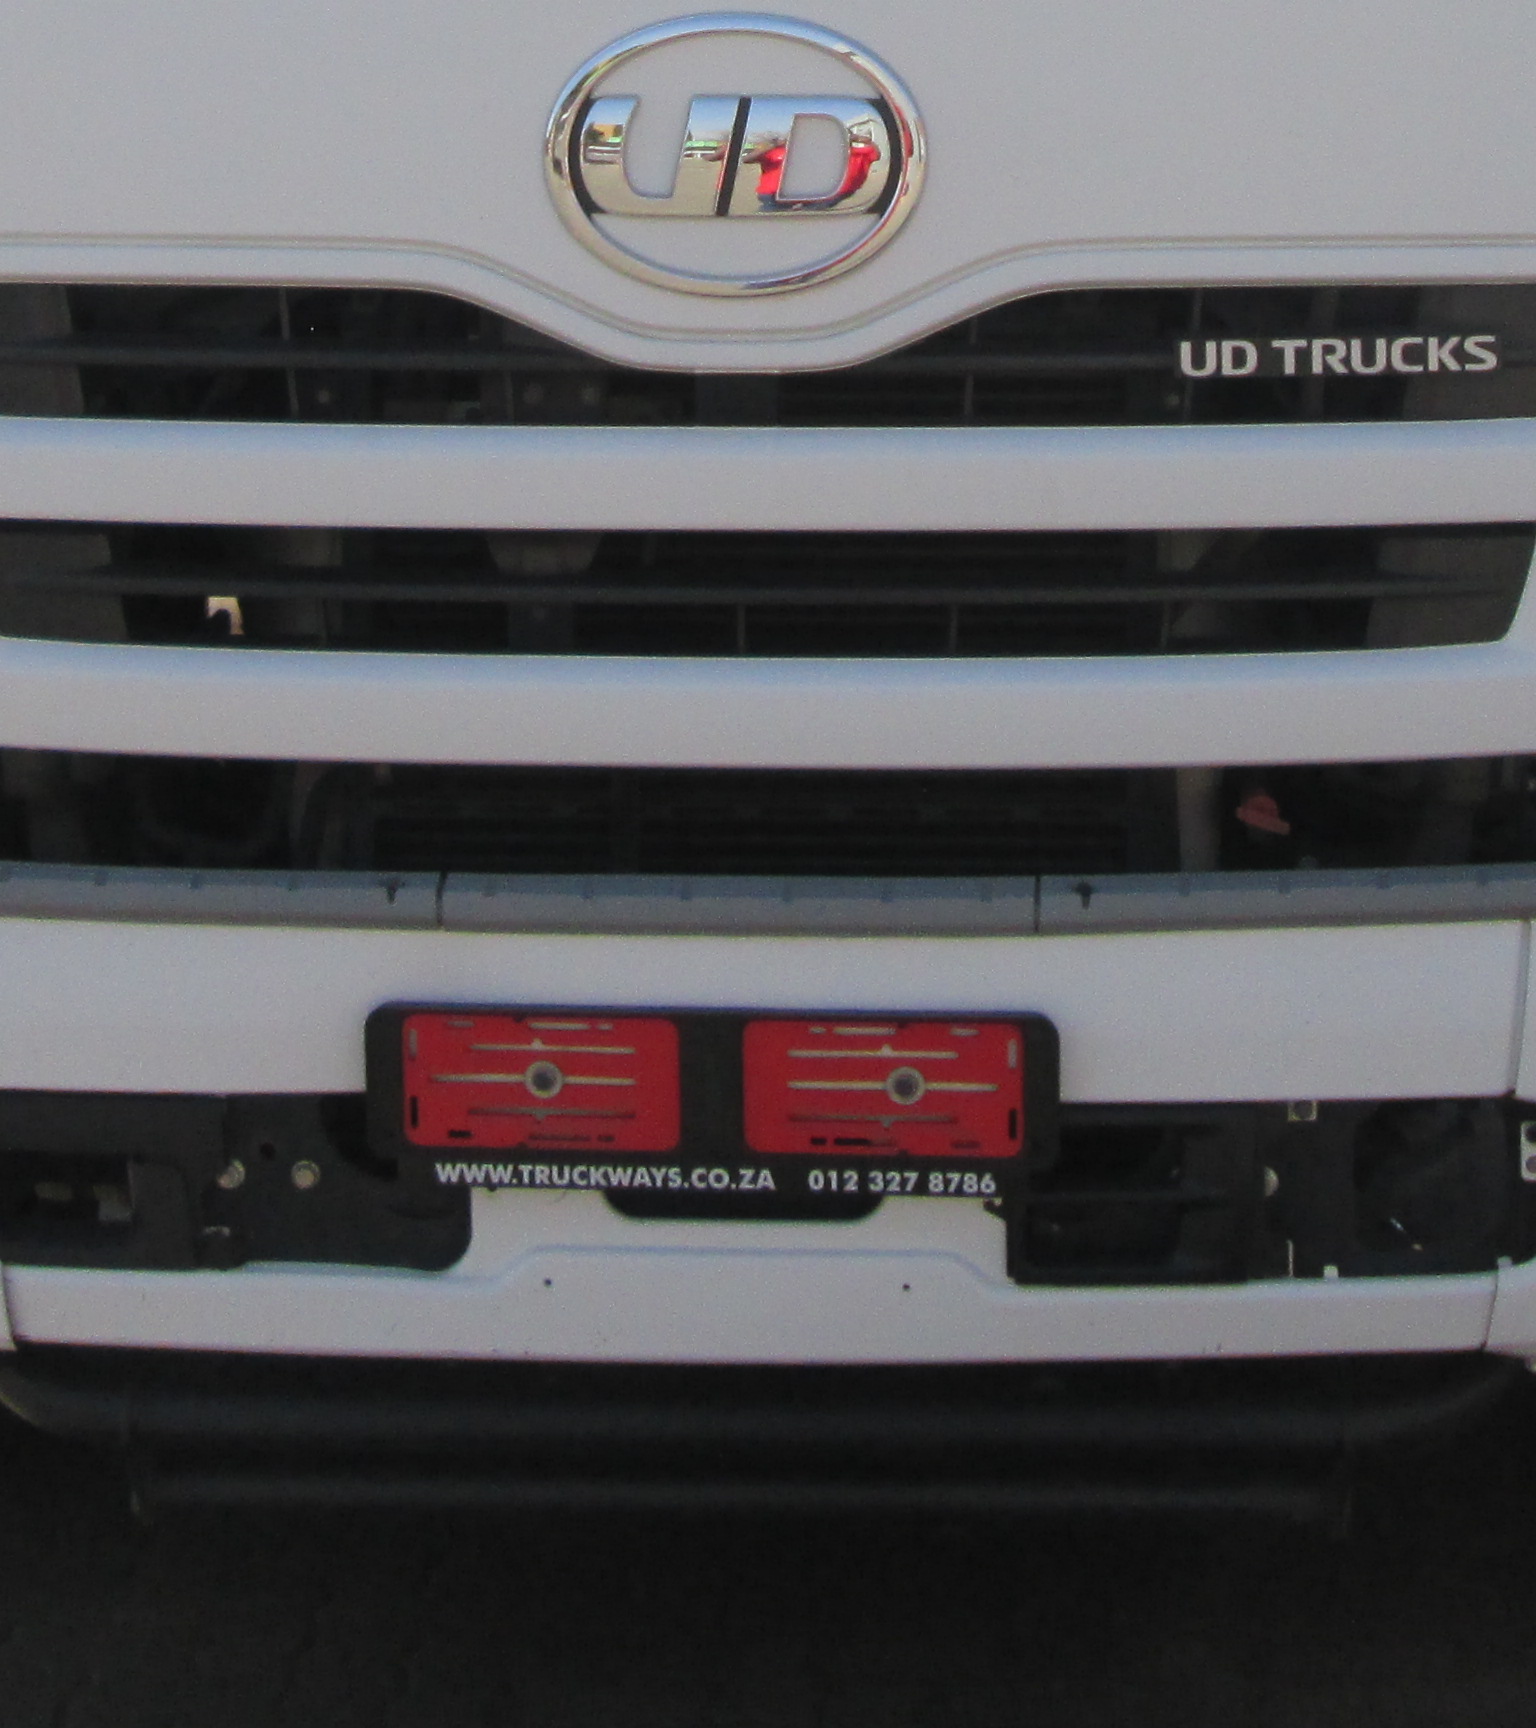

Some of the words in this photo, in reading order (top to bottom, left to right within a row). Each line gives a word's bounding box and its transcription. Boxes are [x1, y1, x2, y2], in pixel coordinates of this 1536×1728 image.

[580, 94, 890, 216] UD
[1179, 339, 1258, 377] UD
[1270, 335, 1498, 375] TRUCKS
[435, 1161, 777, 1191] WWW.TRUCKWAYS.CO.ZA
[807, 1170, 860, 1191] 012
[868, 1171, 920, 1192] 327
[927, 1172, 997, 1194] 8786
